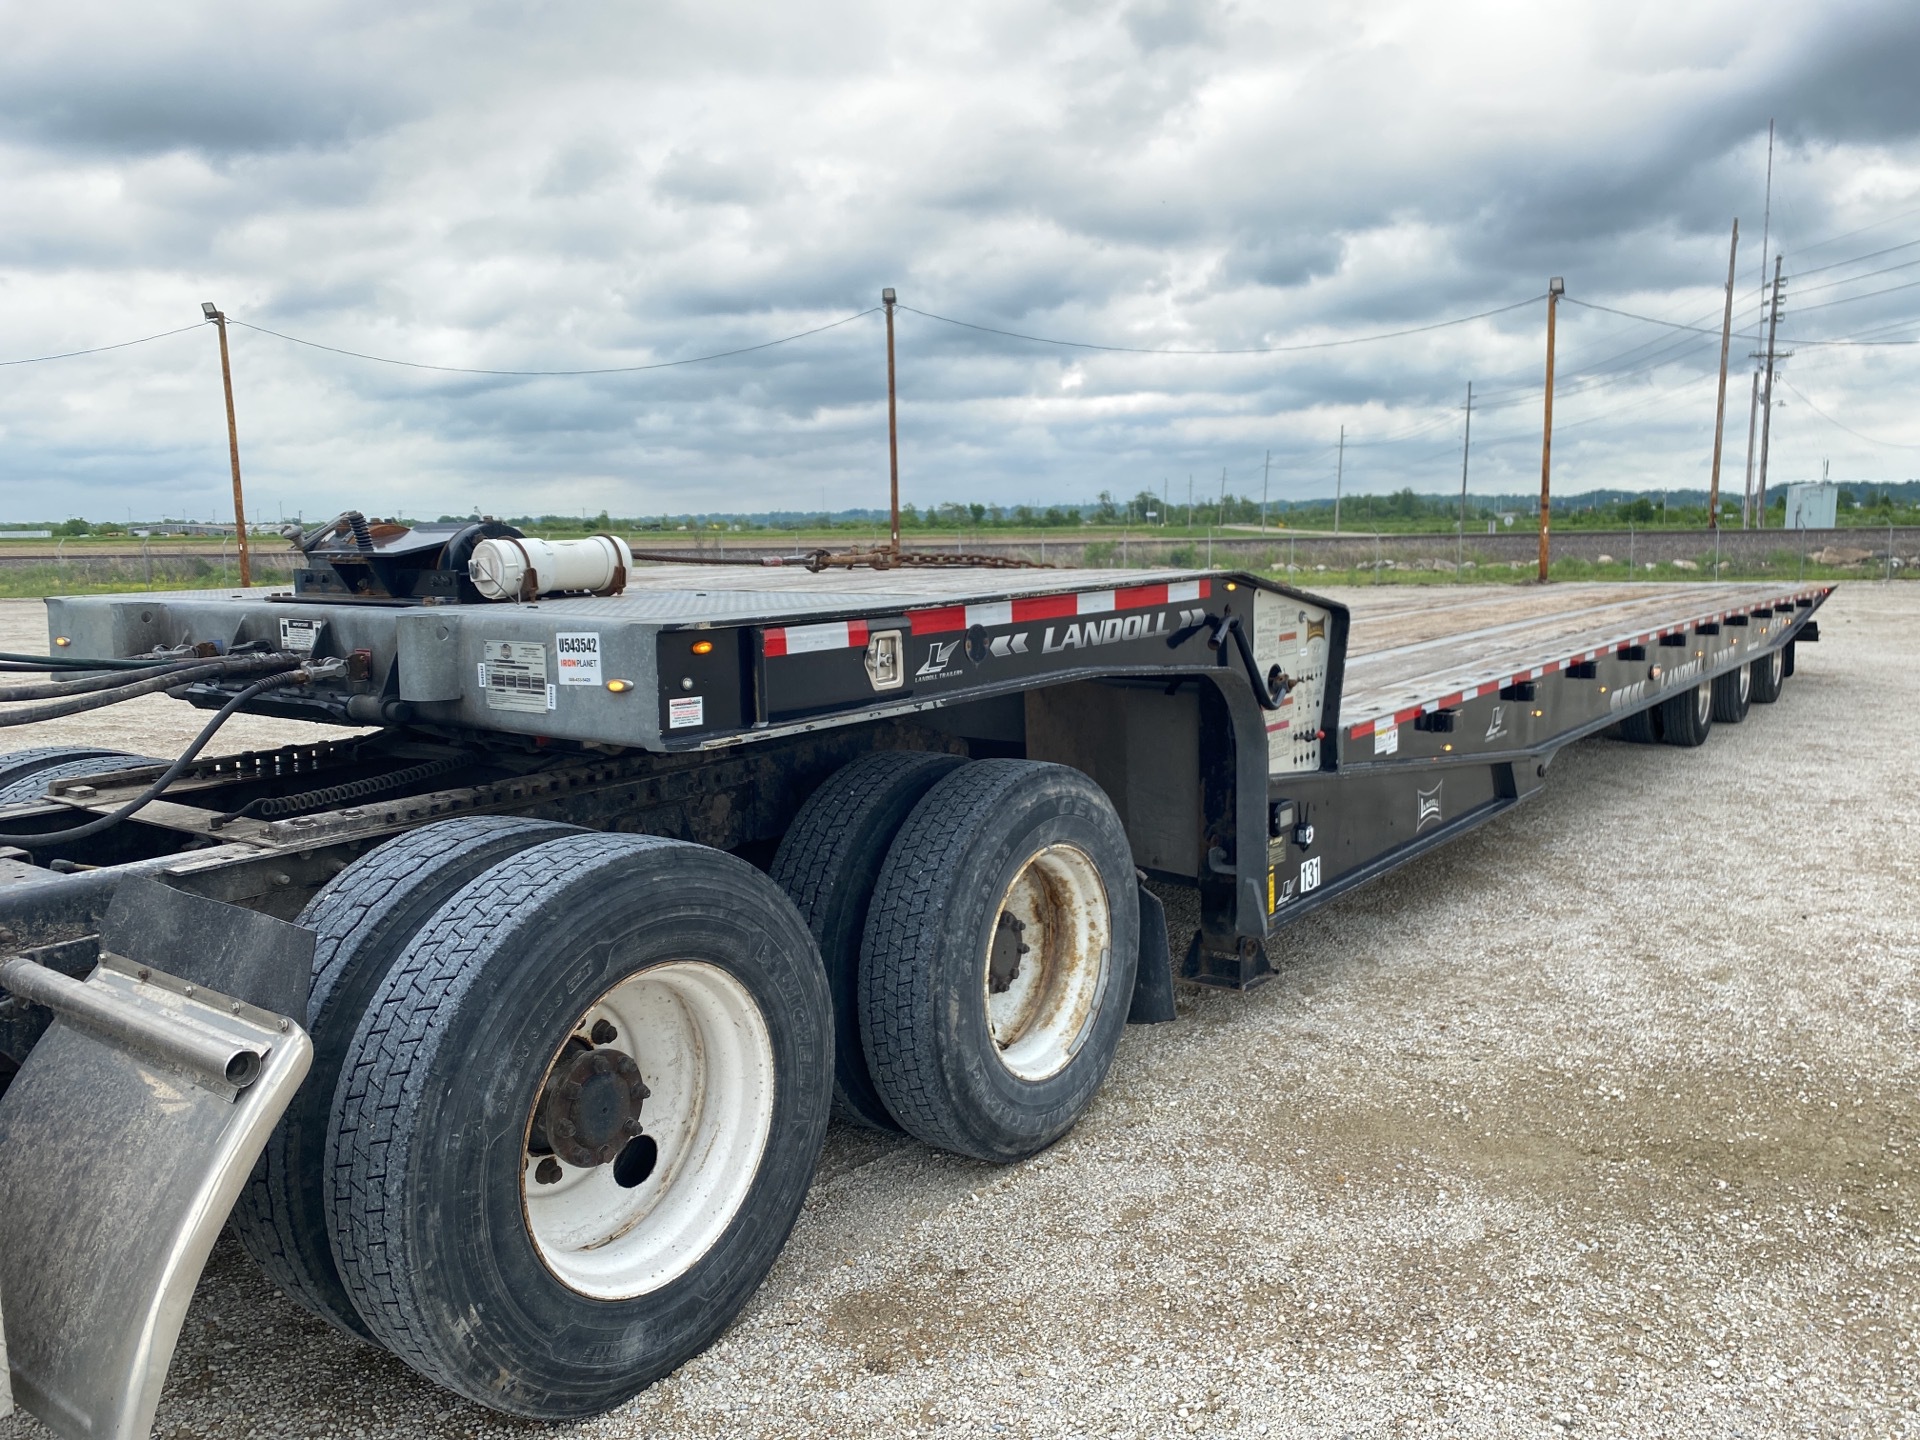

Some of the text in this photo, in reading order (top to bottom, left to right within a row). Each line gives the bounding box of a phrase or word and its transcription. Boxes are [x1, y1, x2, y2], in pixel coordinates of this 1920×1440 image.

[1041, 611, 1170, 655] LANDOLL
[558, 637, 597, 653] U543542
[560, 658, 597, 668] IRONPLANET
[914, 669, 963, 683] LANDOLL TRAILERS
[1302, 859, 1319, 891] 131
